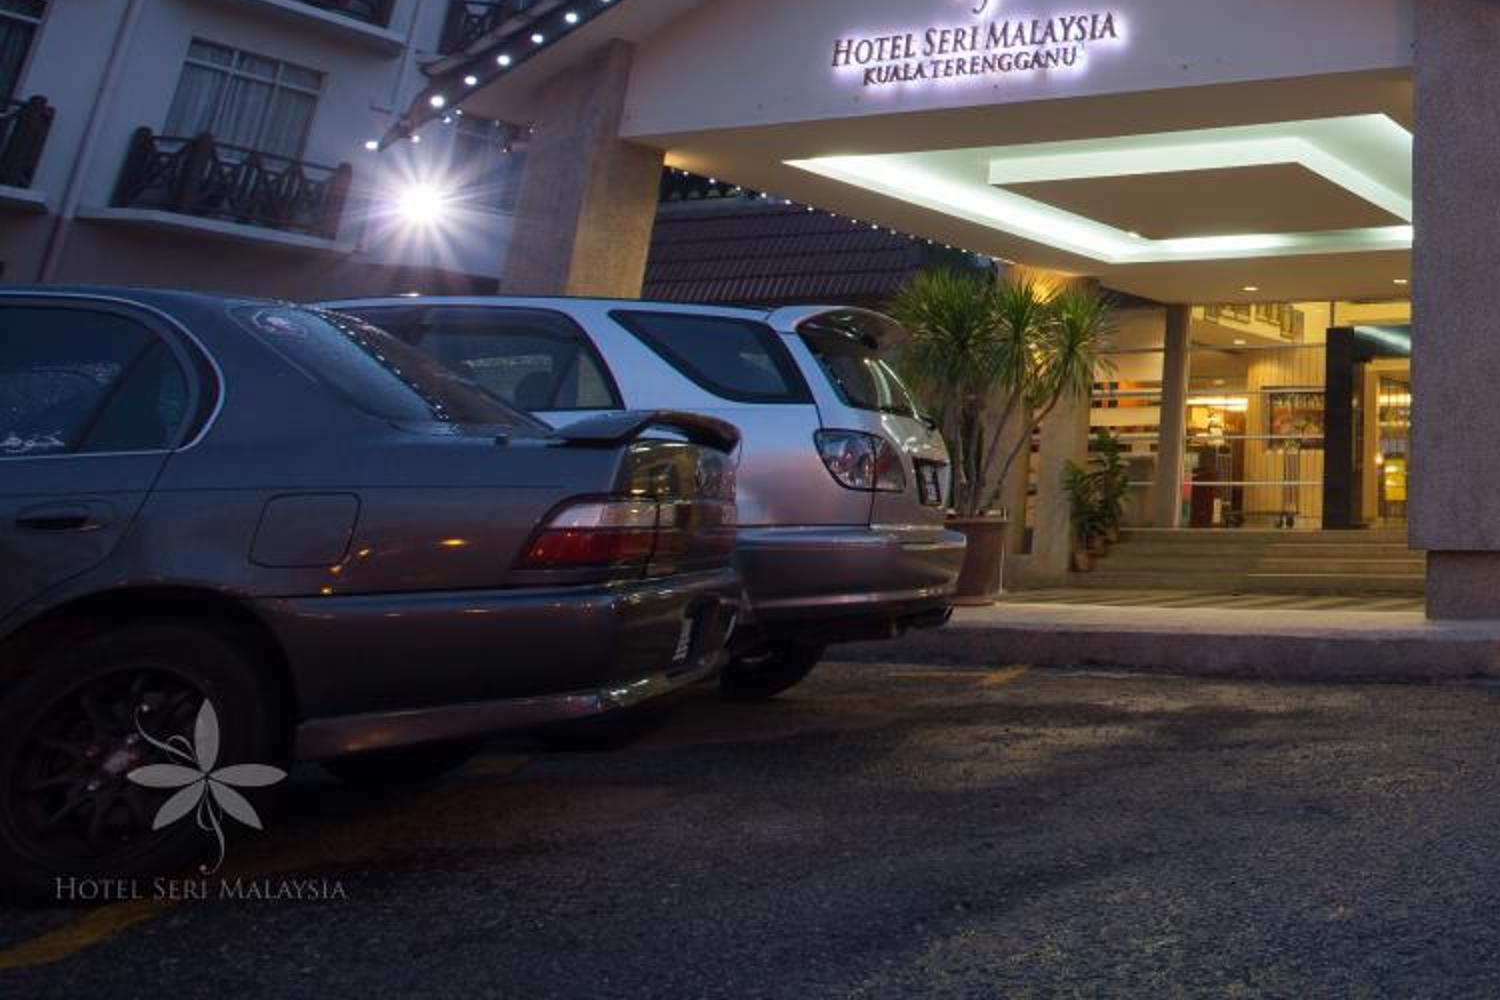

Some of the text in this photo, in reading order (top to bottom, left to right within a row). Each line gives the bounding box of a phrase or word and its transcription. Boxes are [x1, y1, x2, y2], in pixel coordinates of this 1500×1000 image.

[832, 12, 1118, 67] HOTEL SERI MALAYSIA
[863, 47, 1078, 86] KUALA TERENGGANU
